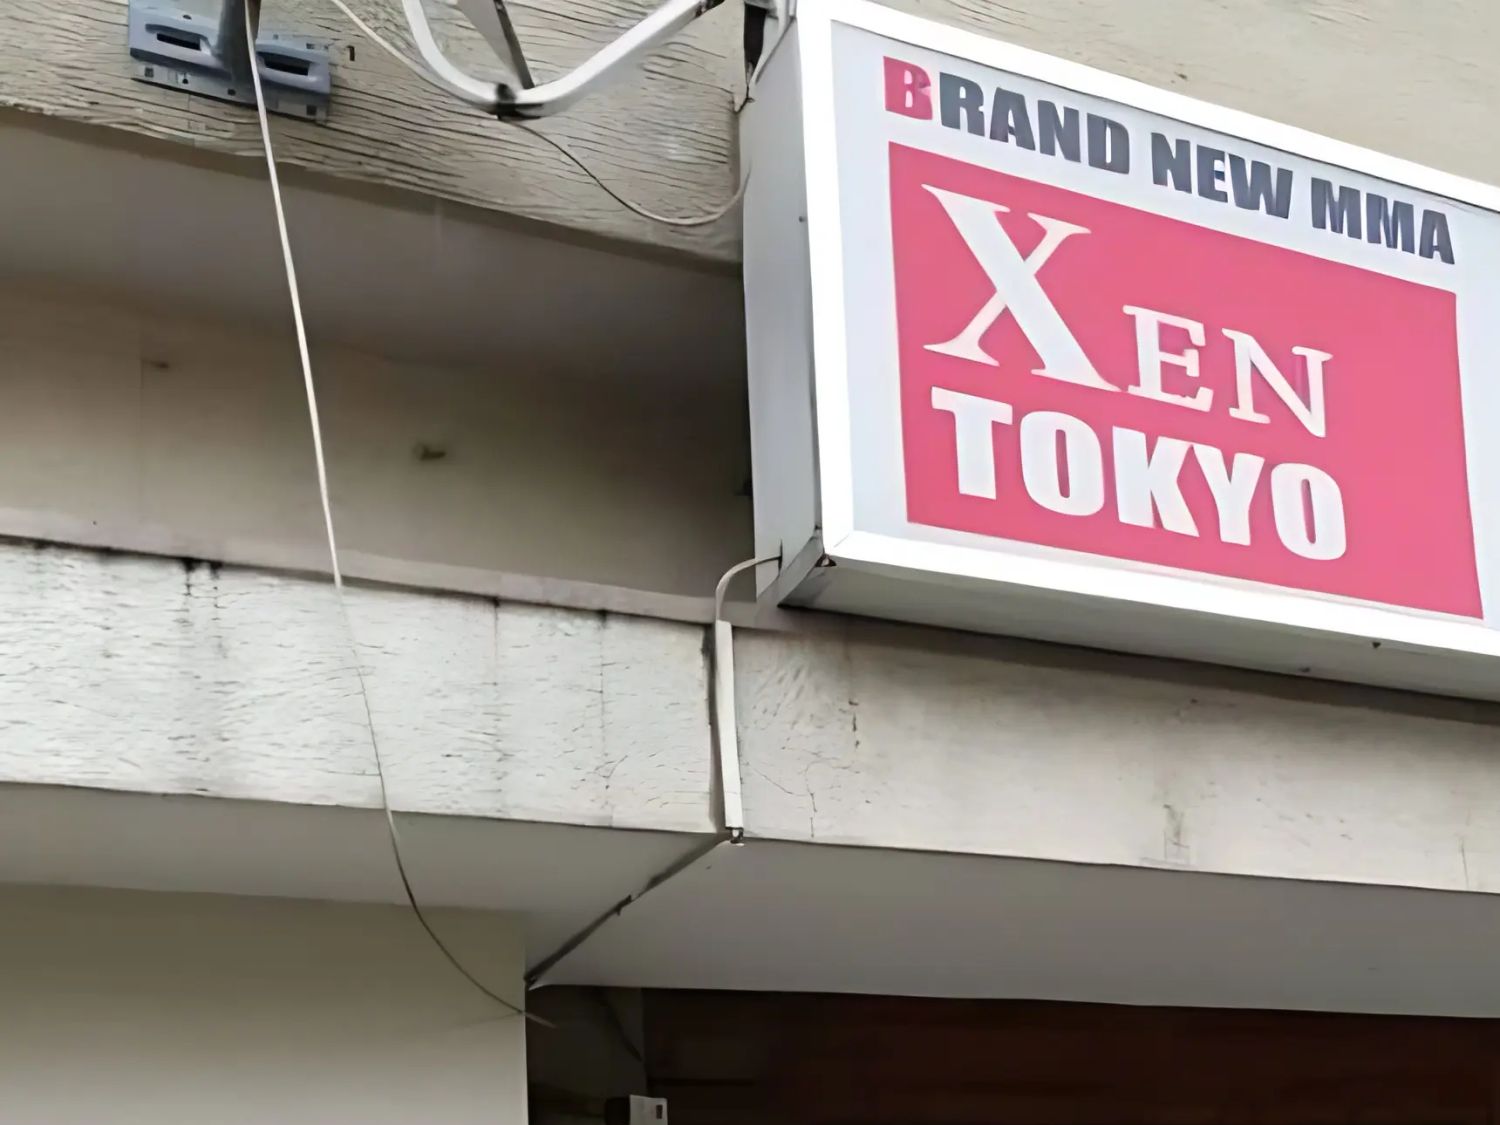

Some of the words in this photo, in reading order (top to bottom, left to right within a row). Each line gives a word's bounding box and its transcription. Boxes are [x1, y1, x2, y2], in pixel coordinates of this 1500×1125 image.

[882, 55, 1131, 175] BRAND
[1150, 131, 1294, 220] NEW
[1310, 177, 1456, 265] MMA
[920, 183, 1333, 438] XEN
[930, 385, 1348, 562] TOKYO
